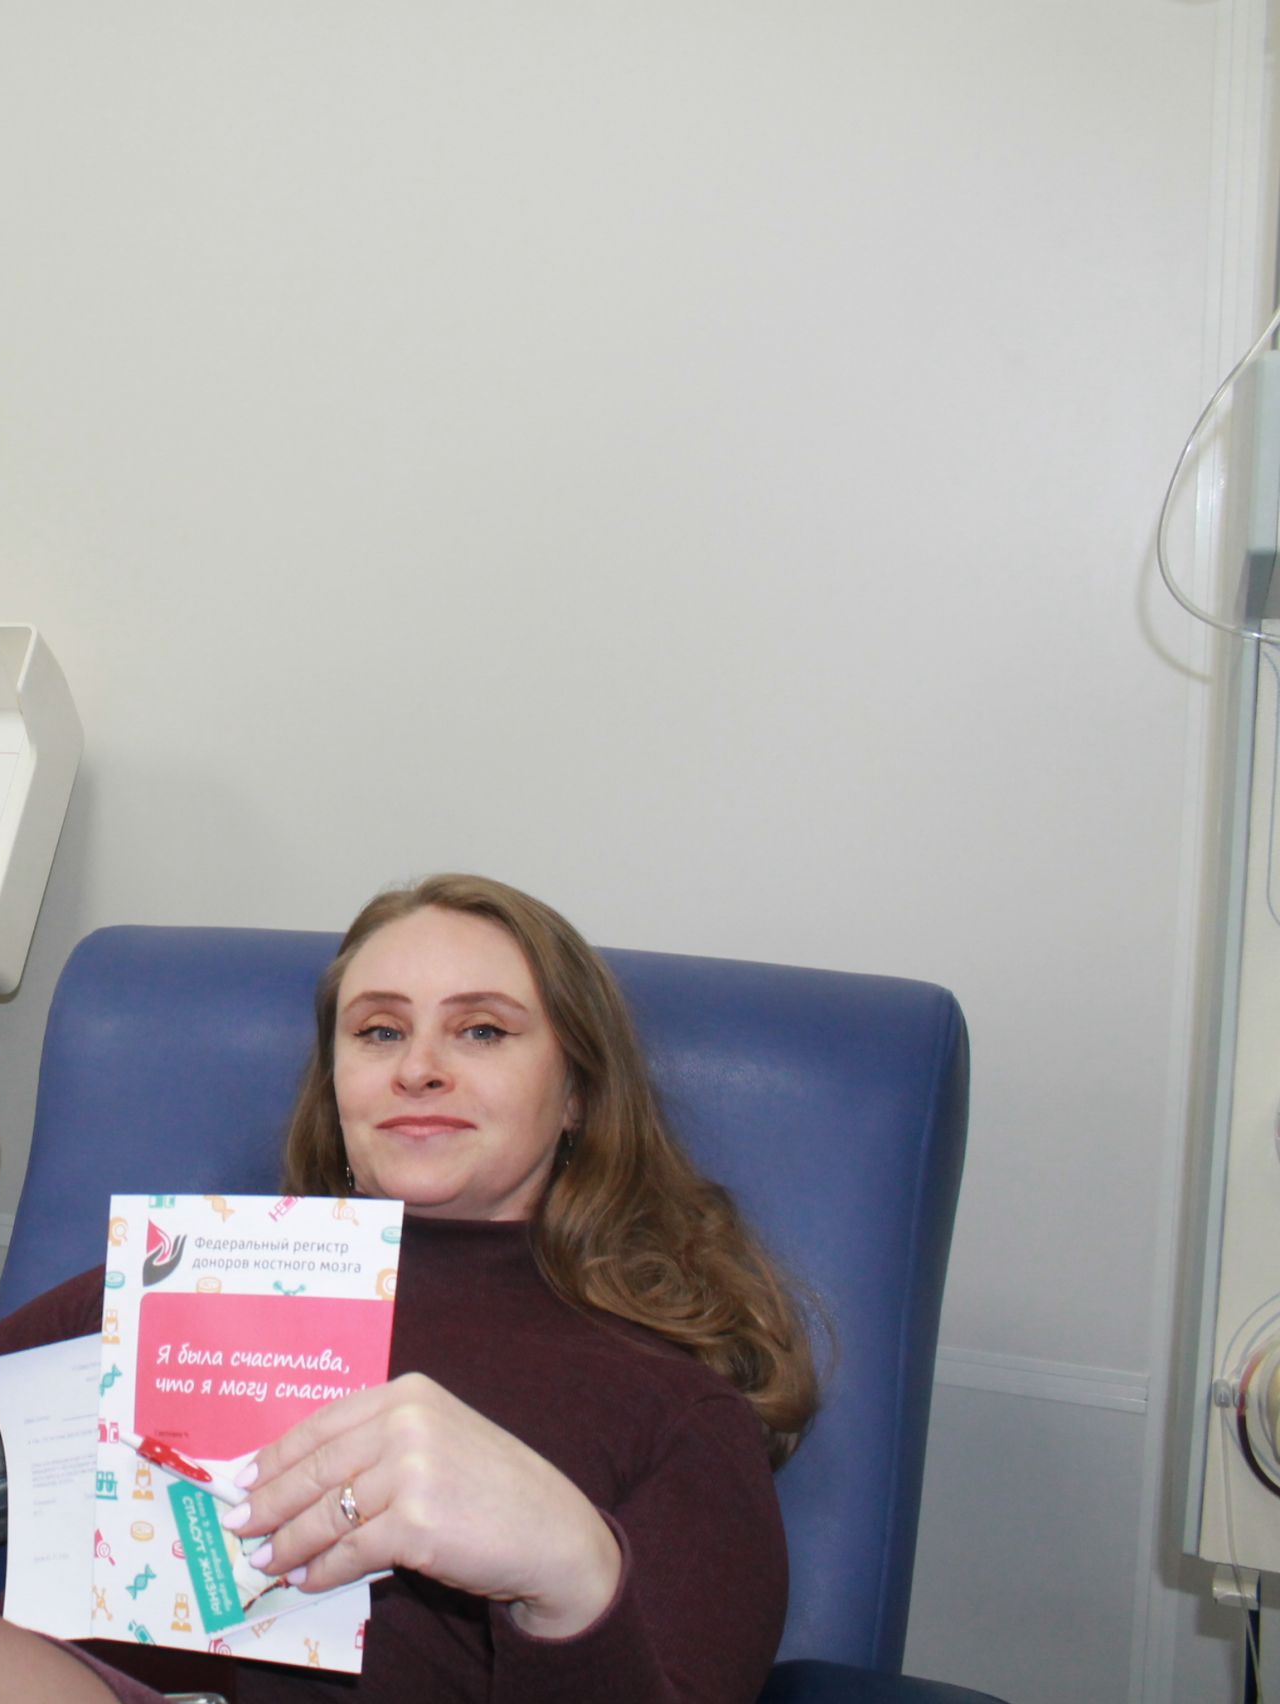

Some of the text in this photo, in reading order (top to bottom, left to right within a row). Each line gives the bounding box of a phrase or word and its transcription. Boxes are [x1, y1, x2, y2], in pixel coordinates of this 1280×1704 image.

[194, 1236, 349, 1256] Федеральный регистр
[192, 1257, 362, 1274] доноров костного мозга
[156, 1342, 350, 1374] Я была счастлива,
[155, 1377, 195, 1394] что
[201, 1379, 212, 1394] я
[219, 1378, 268, 1402] могу
[182, 1495, 223, 1616] СПАСУТ ЖИЗНЬ!
